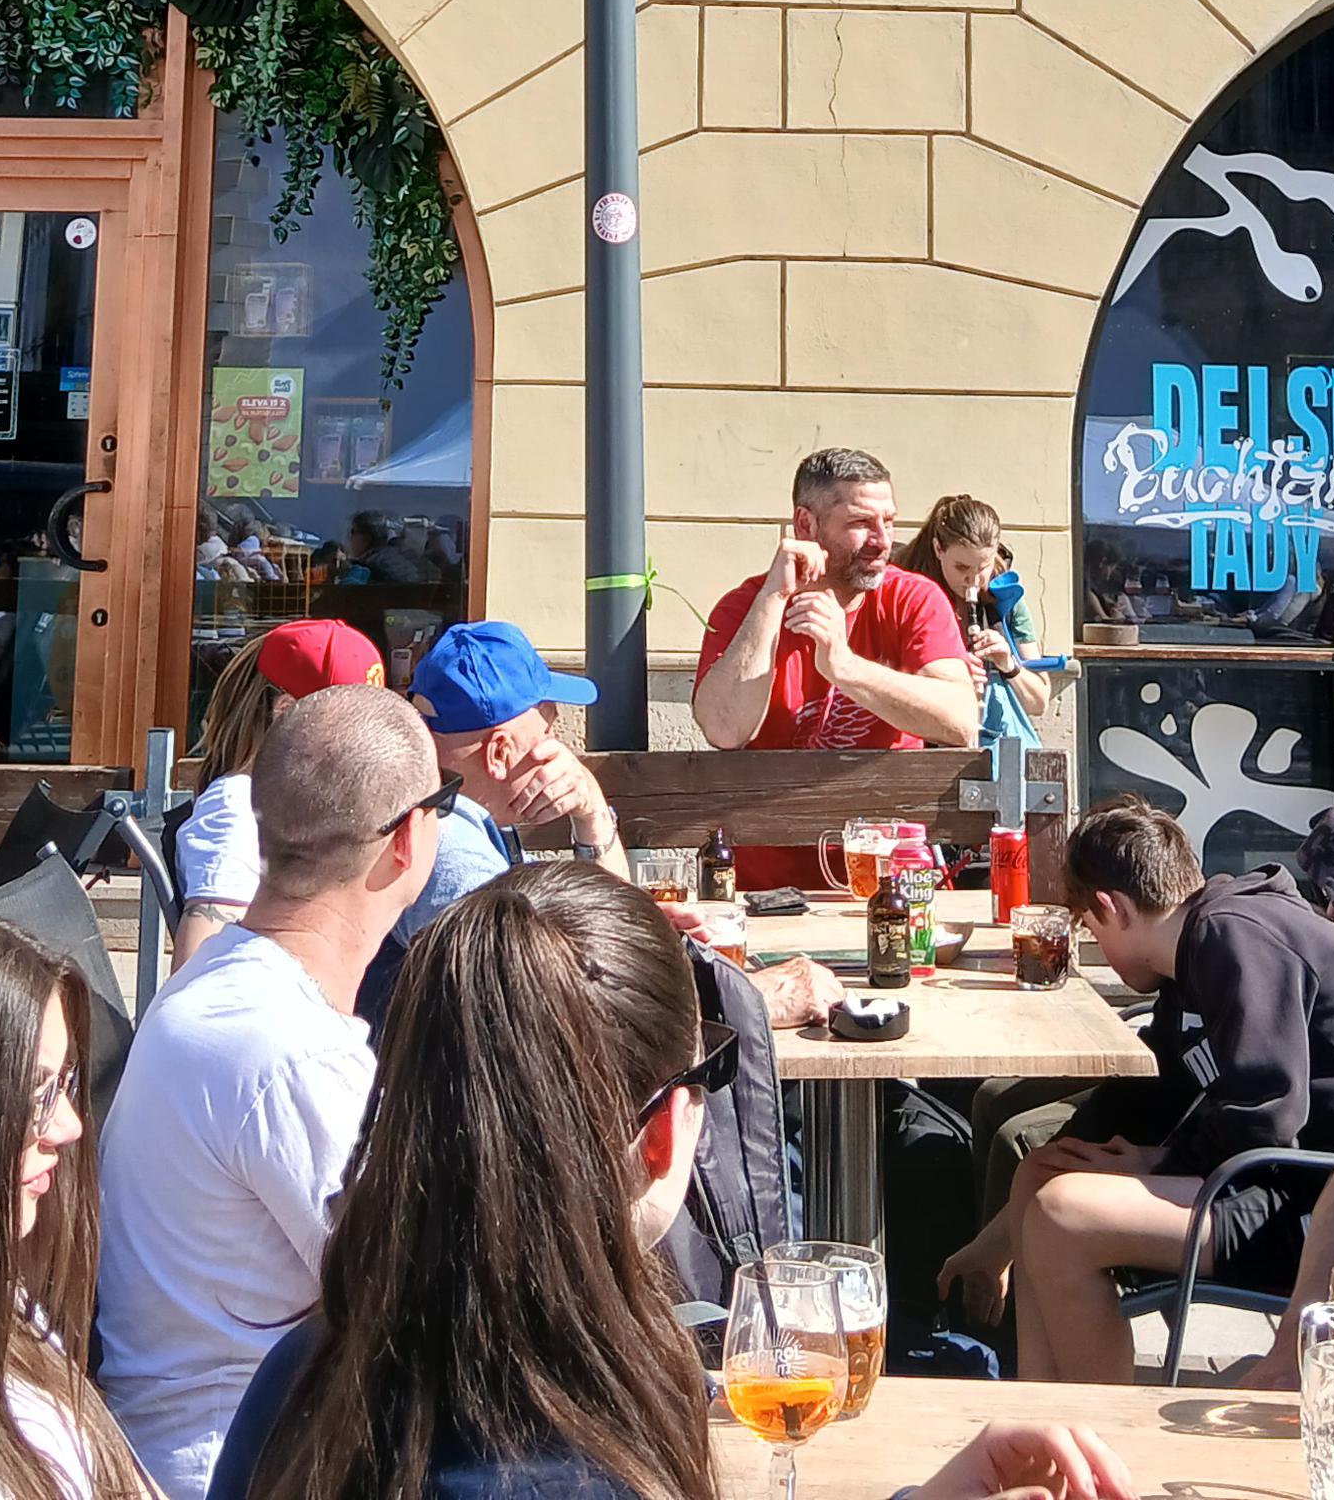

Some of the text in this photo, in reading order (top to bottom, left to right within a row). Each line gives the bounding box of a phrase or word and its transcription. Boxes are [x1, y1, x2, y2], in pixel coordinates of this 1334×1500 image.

[1184, 501, 1325, 593] TADY
[898, 869, 932, 883] Aloe
[899, 884, 933, 902] King
